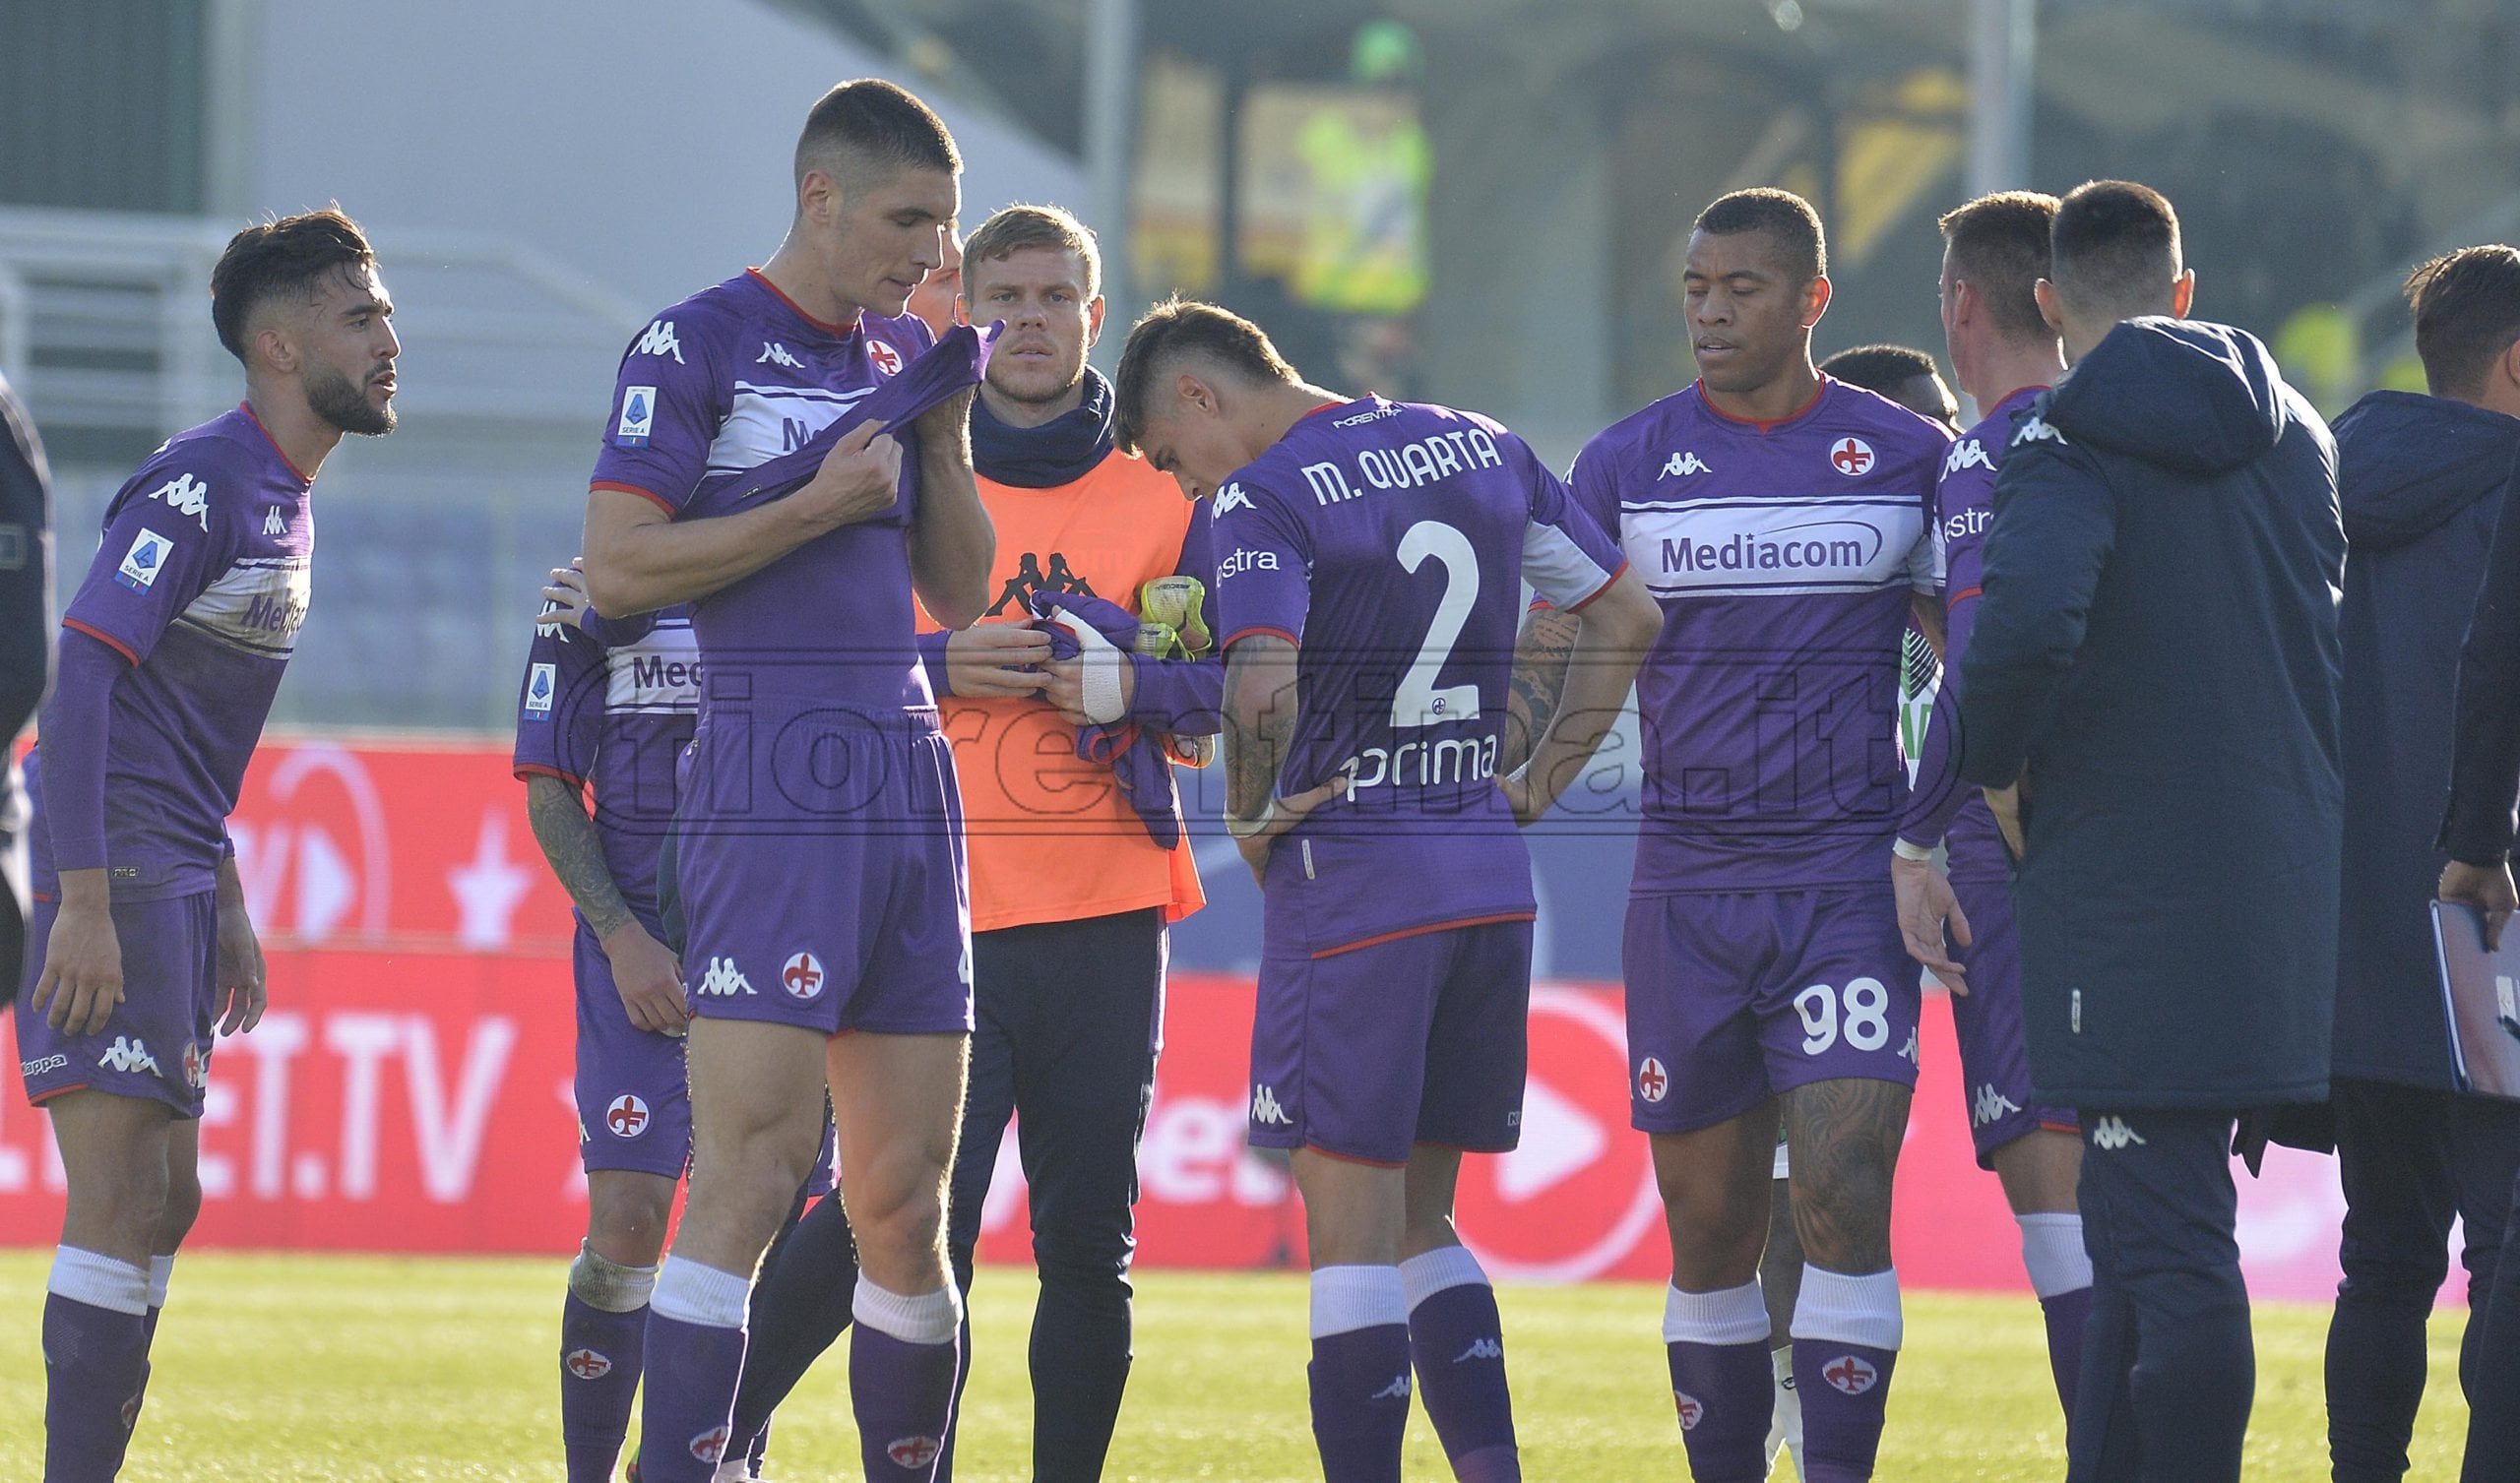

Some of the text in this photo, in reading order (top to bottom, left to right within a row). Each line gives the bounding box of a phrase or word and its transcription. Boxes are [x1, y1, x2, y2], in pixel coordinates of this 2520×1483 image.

[1300, 428, 1502, 506] M. QUARTA
[1662, 532, 1862, 573] Mediacom
[1944, 507, 1994, 544] estr
[1389, 520, 1480, 728] 2
[1339, 734, 1497, 803] prima
[1794, 977, 1889, 1056] 98
[22, 1054, 68, 1077] appa
